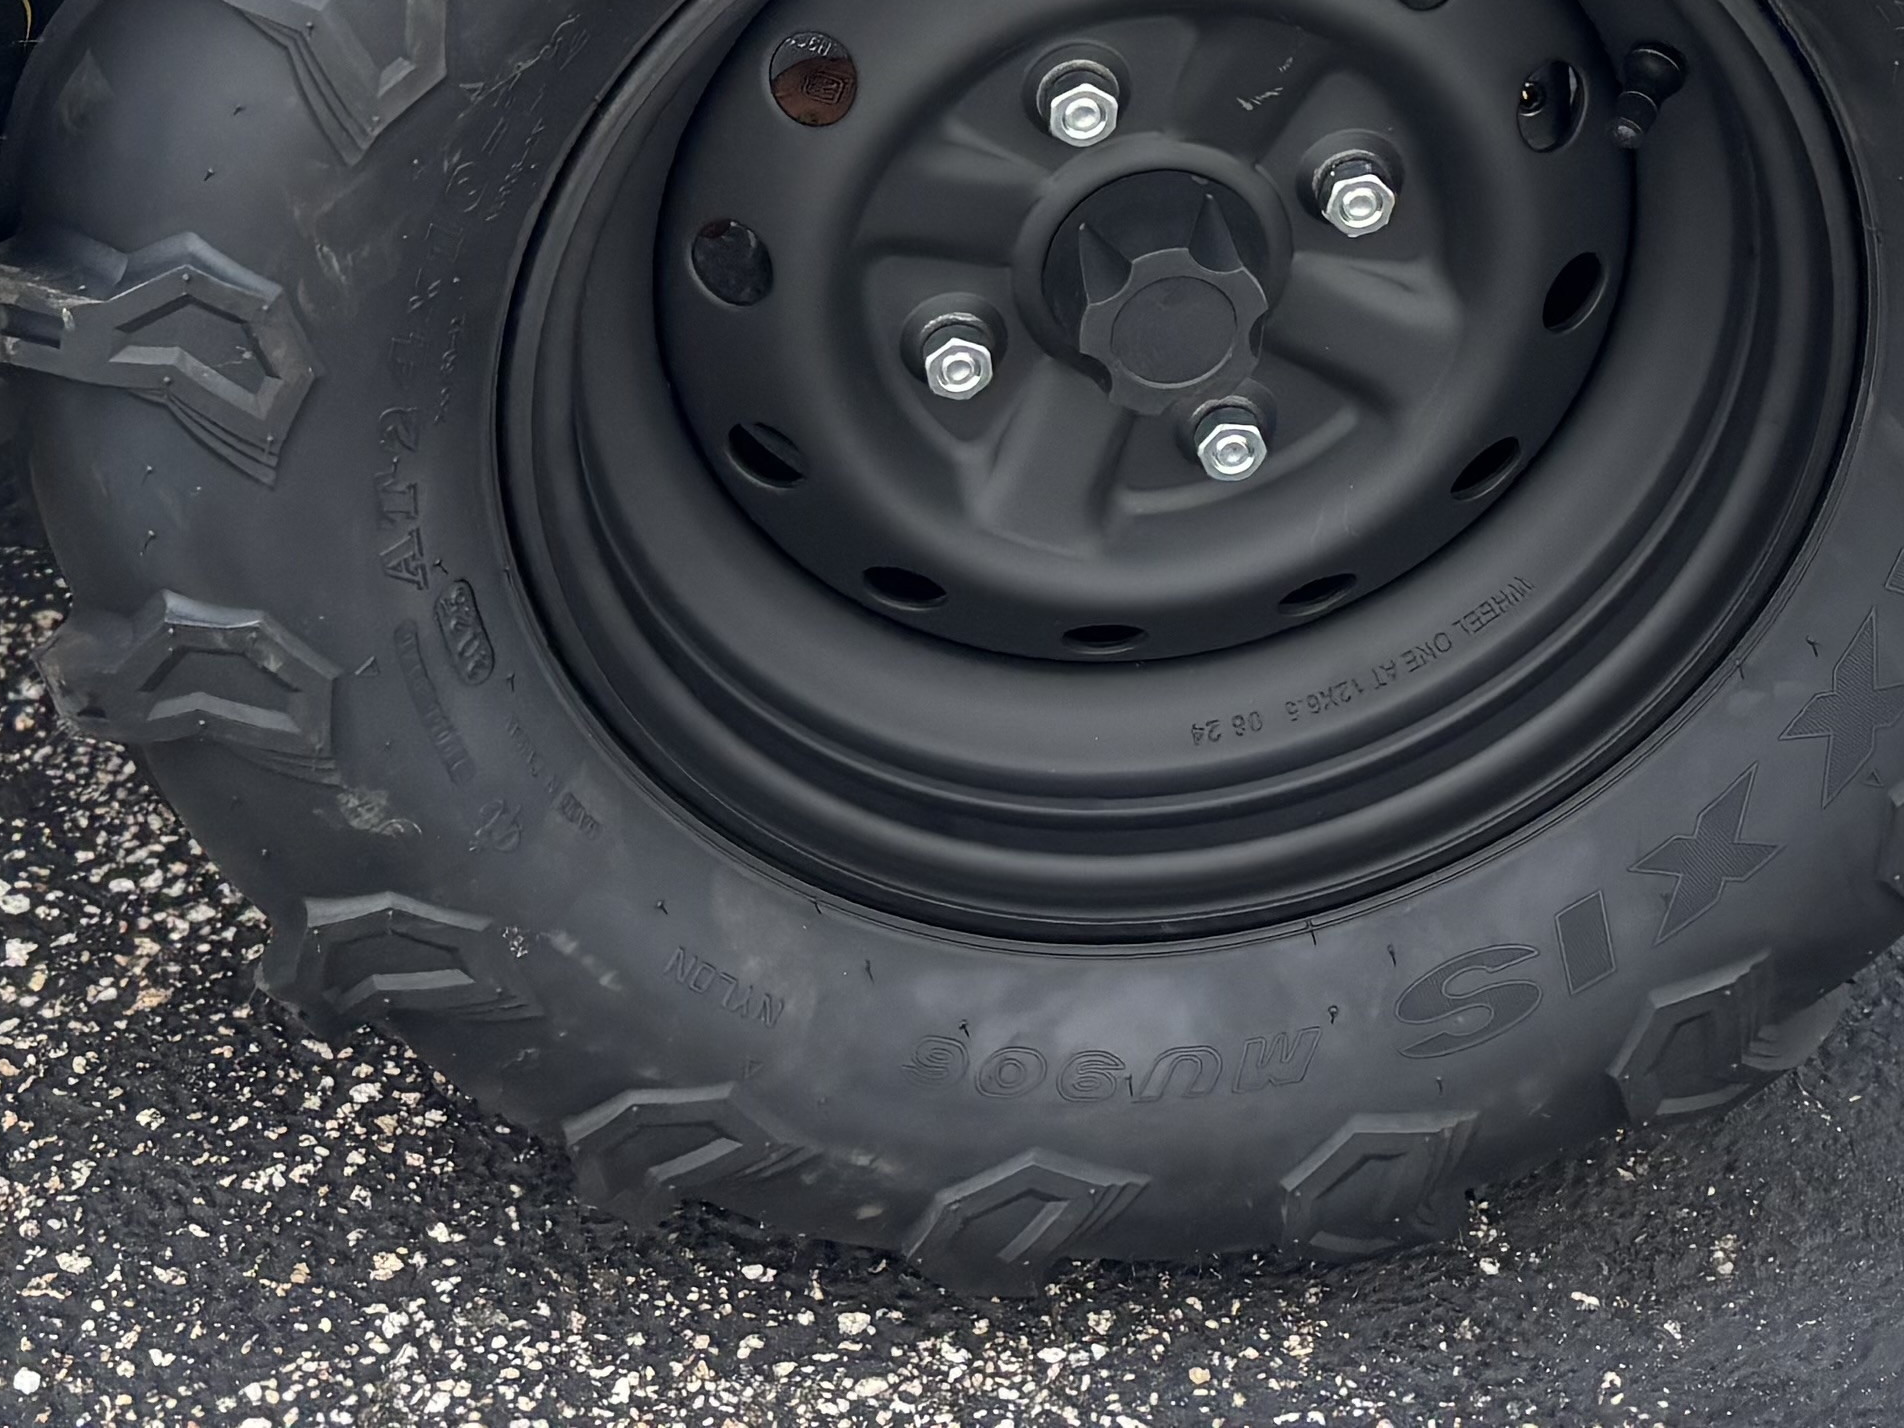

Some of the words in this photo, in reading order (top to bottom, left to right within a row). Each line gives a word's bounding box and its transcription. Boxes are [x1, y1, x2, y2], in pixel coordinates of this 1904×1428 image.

[1451, 576, 1536, 637] WHEEL
[1371, 659, 1397, 691] AT
[1402, 631, 1453, 673] ONE
[662, 946, 786, 1030] NYLON
[904, 1023, 1322, 1104] MU906
